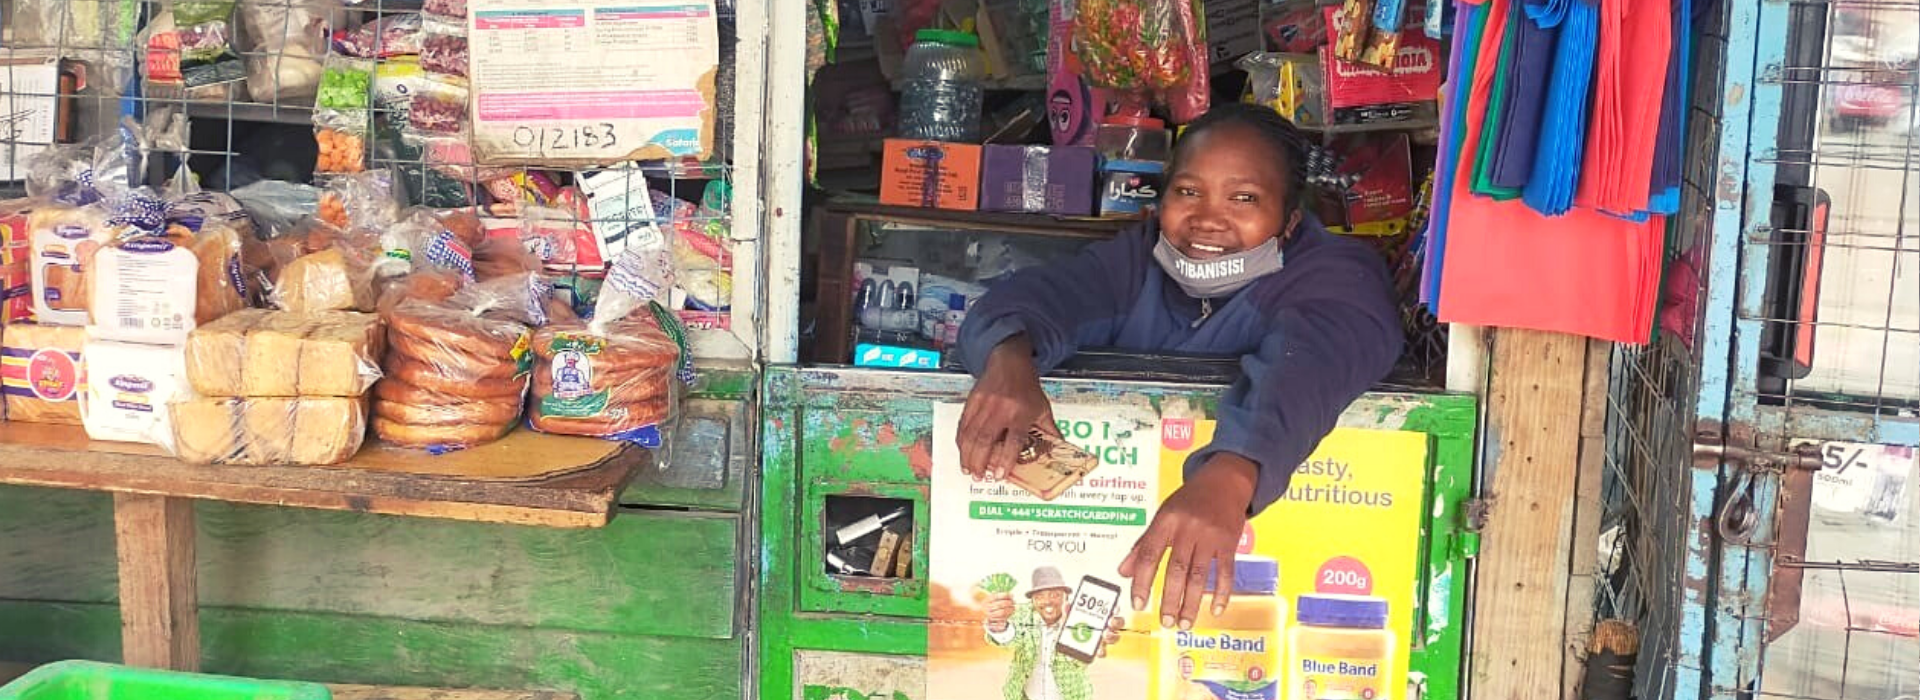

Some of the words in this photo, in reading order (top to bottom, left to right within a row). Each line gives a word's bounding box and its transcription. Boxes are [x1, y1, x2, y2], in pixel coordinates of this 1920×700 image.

[514, 122, 616, 155] 012183
[1163, 424, 1192, 441] NEW
[1085, 444, 1138, 466] UCH
[1824, 445, 1868, 475] 5/-
[1296, 457, 1353, 482] asty,
[1088, 475, 1147, 490] airtime
[1079, 492, 1108, 503] every
[1283, 483, 1393, 507] utritious
[978, 506, 1004, 516] DIAL
[1027, 539, 1053, 553] FOR
[1056, 540, 1087, 555] YOU
[1323, 569, 1367, 588] 200g
[1076, 593, 1109, 616] 50%
[1176, 631, 1216, 649] Blue
[1220, 634, 1265, 653] Band
[1302, 658, 1336, 674] Blue
[1338, 661, 1377, 677] Band
